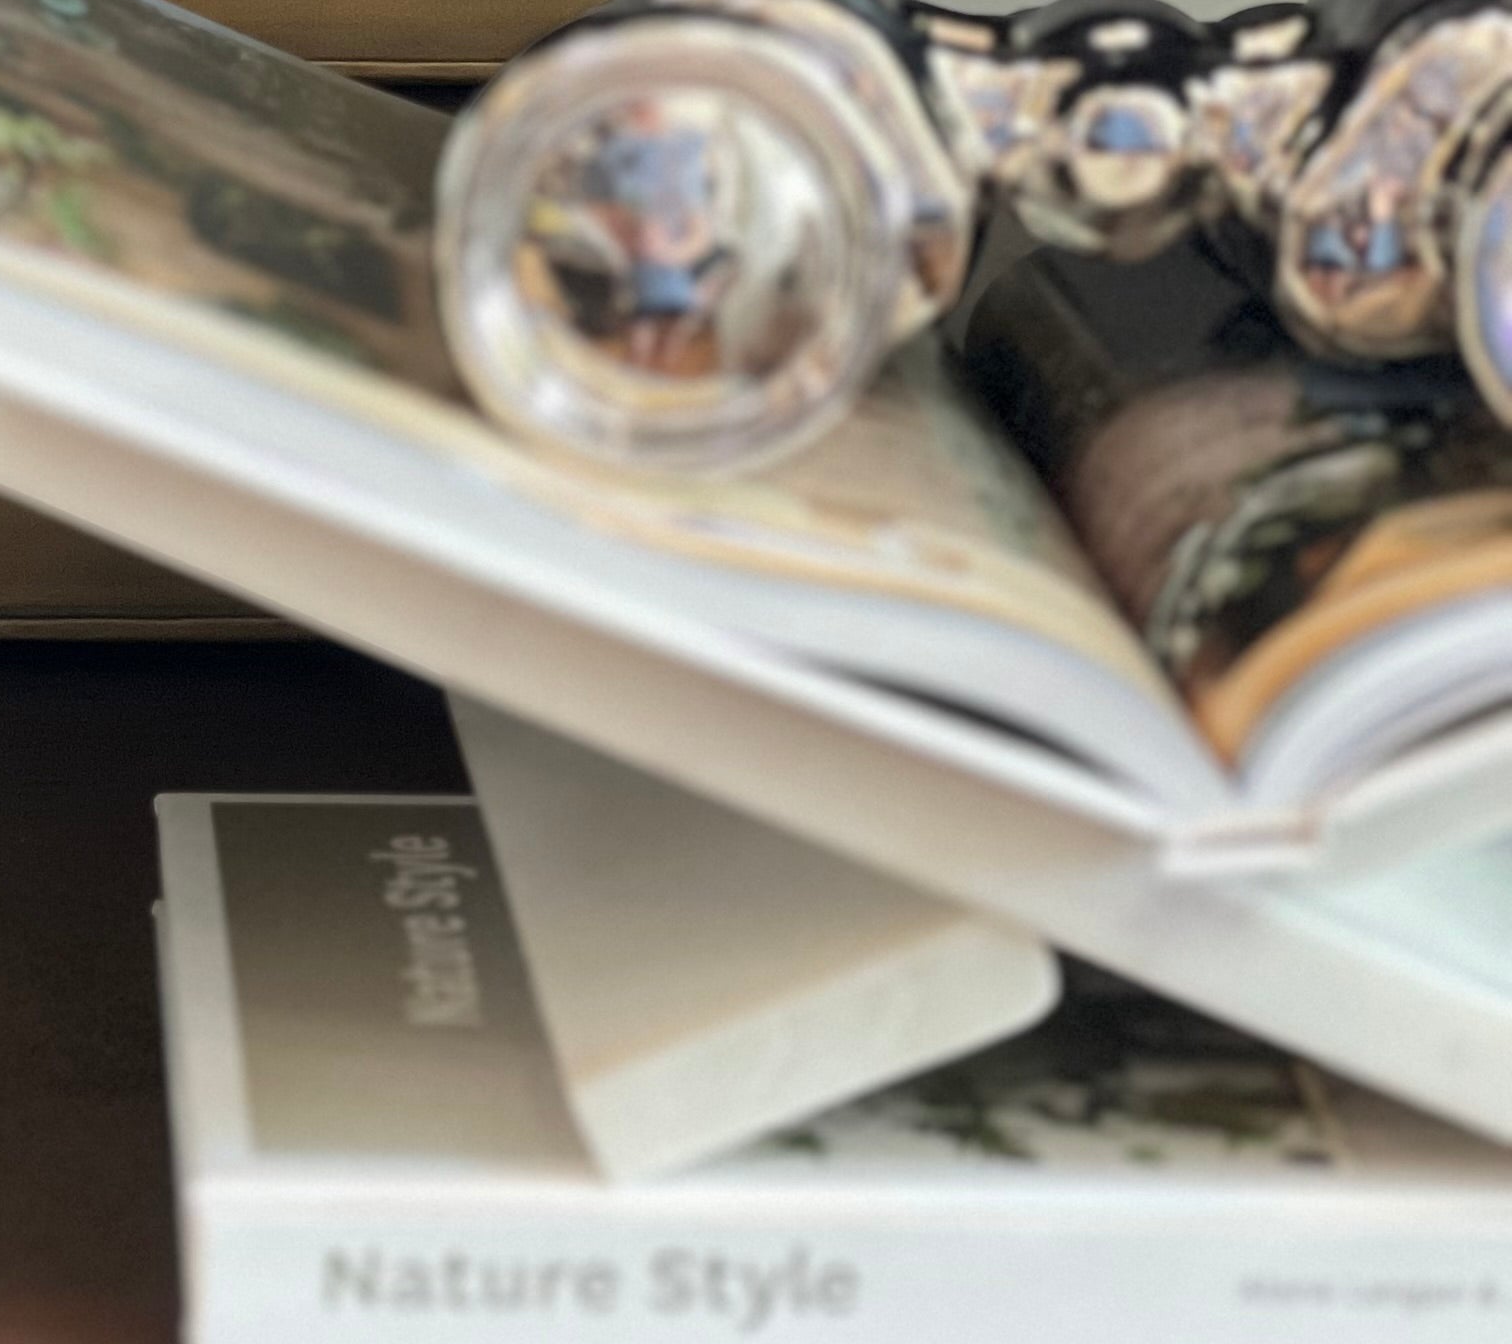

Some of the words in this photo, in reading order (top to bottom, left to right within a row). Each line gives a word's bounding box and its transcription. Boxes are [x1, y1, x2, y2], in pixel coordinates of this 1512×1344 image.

[369, 834, 478, 909] Style
[403, 915, 483, 1029] Nature
[318, 1246, 620, 1314] Nature
[643, 1246, 862, 1334] Style
